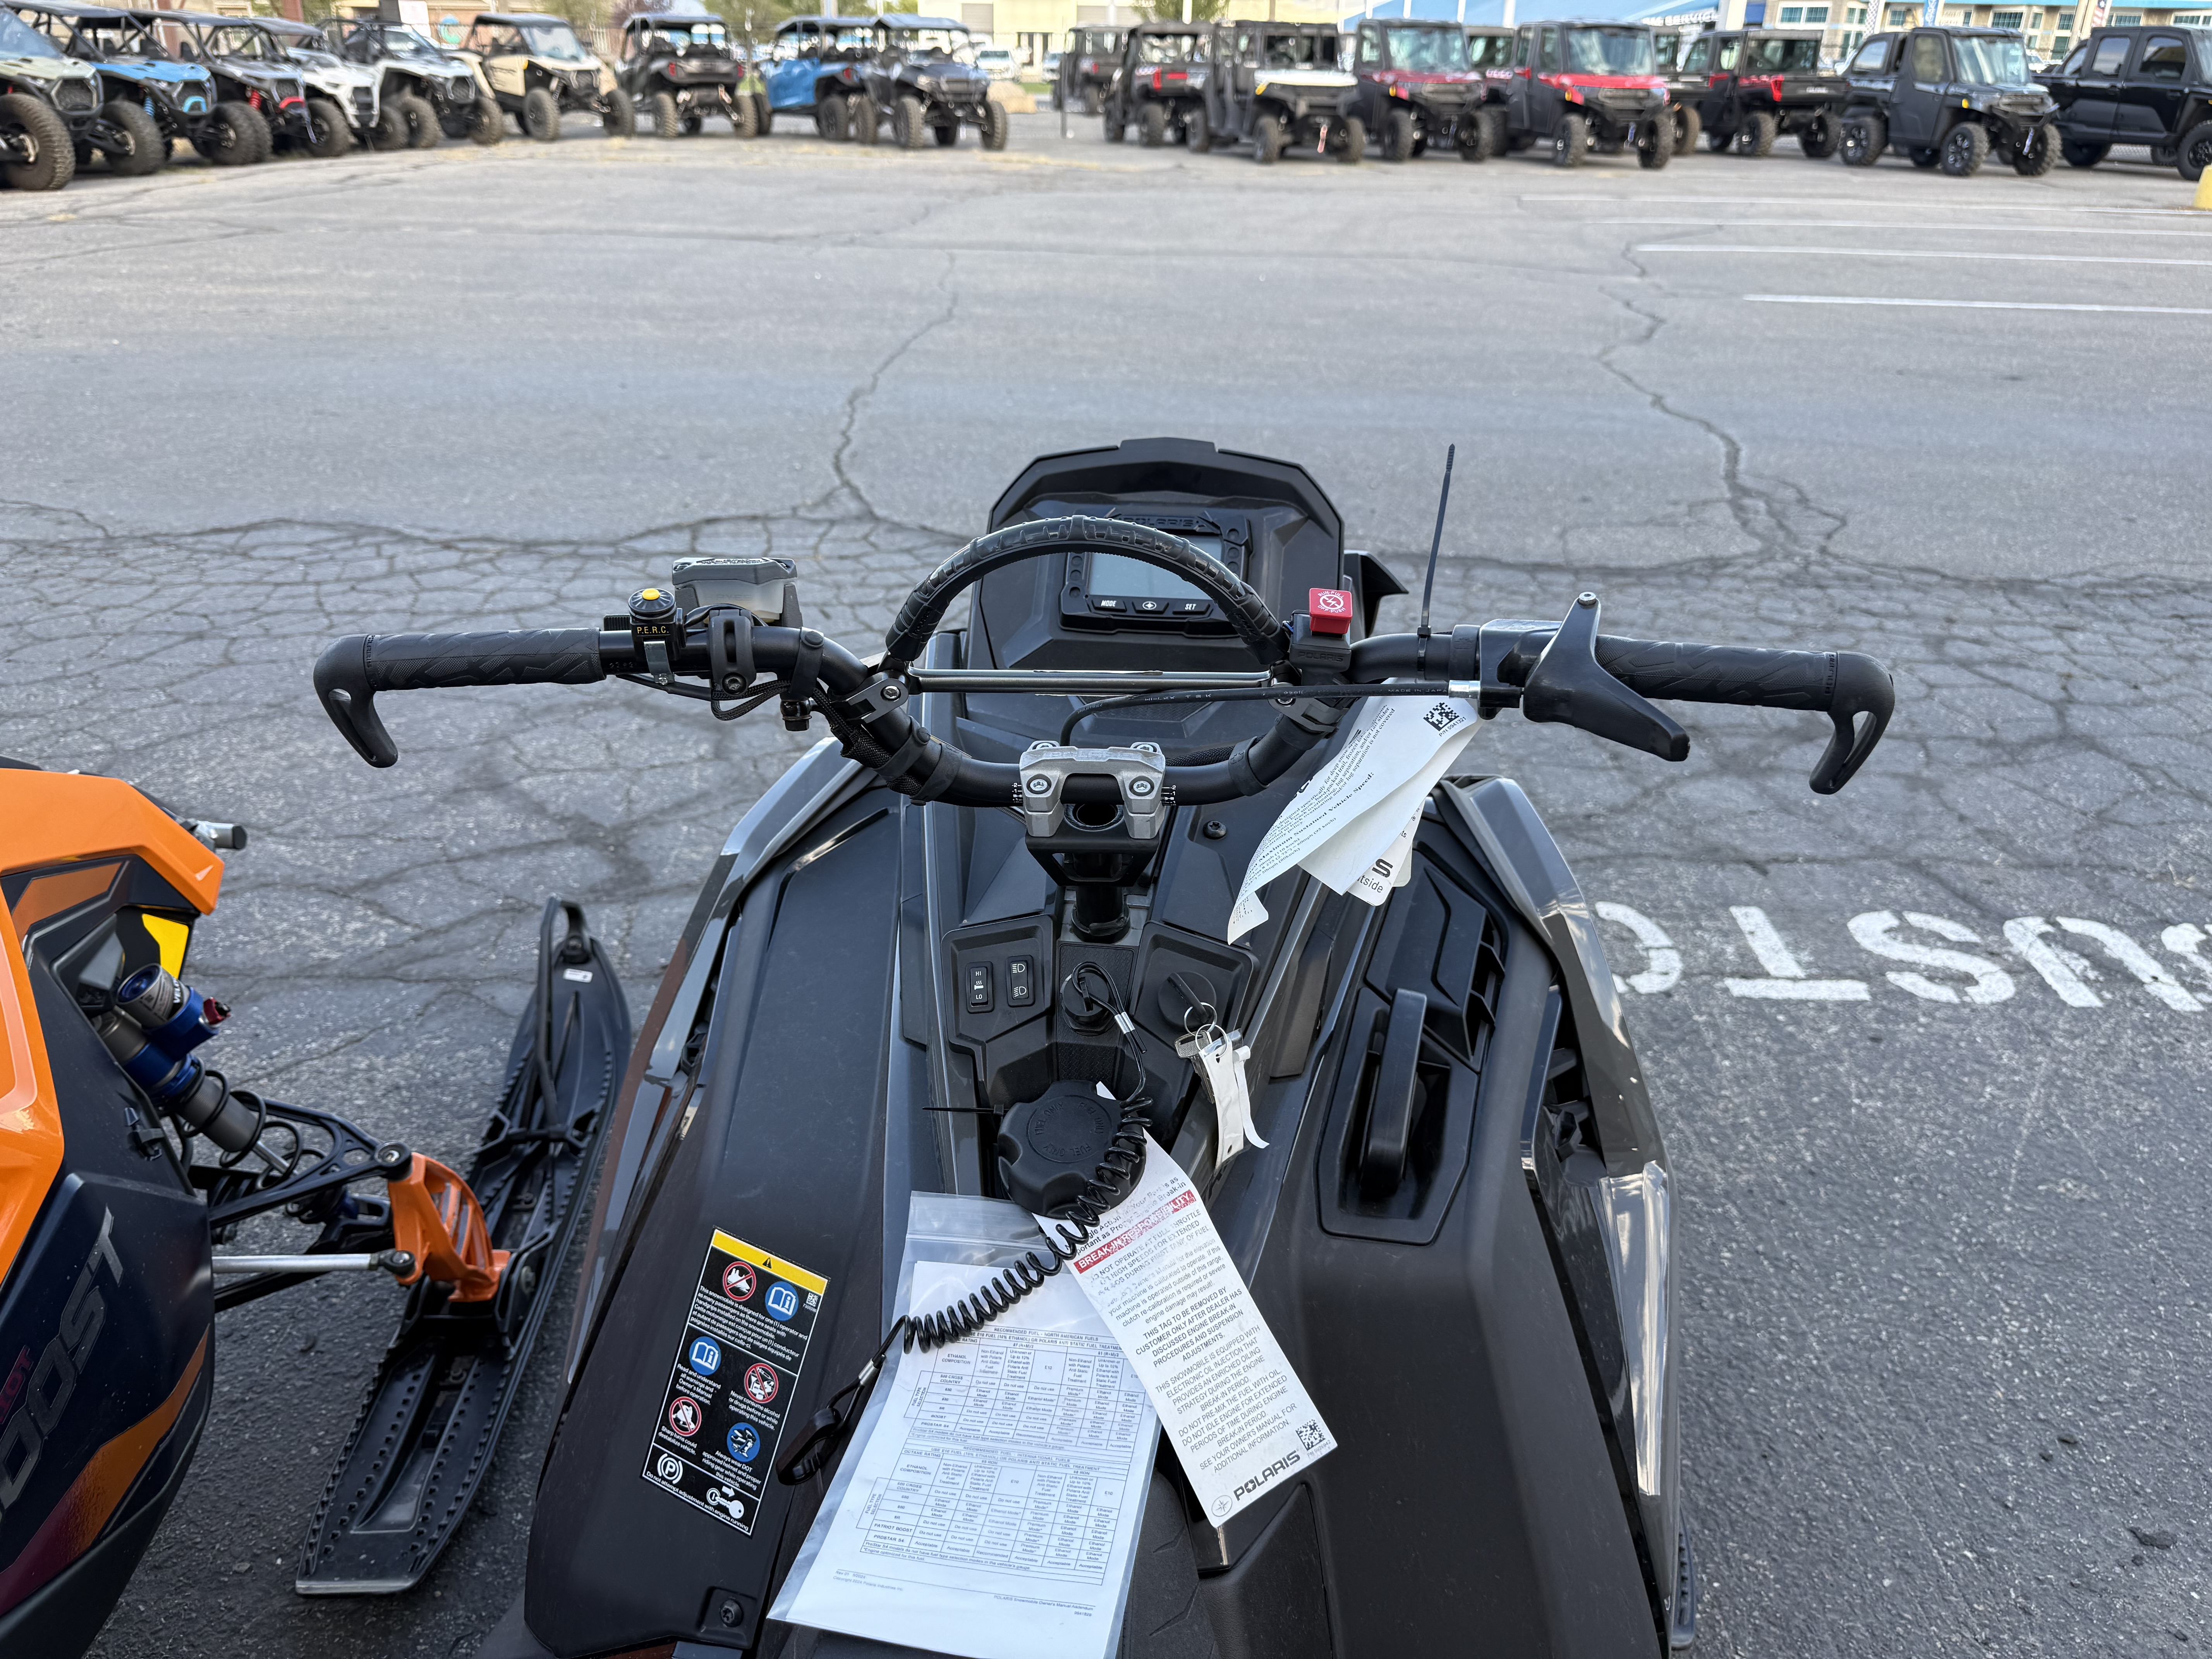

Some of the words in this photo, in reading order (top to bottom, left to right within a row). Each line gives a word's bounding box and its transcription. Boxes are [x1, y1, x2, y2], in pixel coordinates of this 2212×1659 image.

[637, 626, 669, 634] P.E.R.C.
[1298, 651, 1343, 662] POLARIS
[1330, 763, 1339, 775] deep
[1338, 747, 1348, 762] snow
[1335, 777, 1344, 786] lug
[1342, 750, 1361, 777] separation,
[1360, 732, 1371, 749] and/or
[1377, 707, 1389, 721] slider
[1338, 761, 1348, 773] trail,
[1346, 743, 1358, 759] frozen
[1345, 771, 1354, 781] lug
[1353, 745, 1370, 771] separation
[1379, 708, 1395, 729] covered
[1294, 812, 1327, 835] Sustained
[1328, 793, 1352, 811] Vehicle
[1353, 772, 1374, 792] Speed:
[1357, 874, 1384, 893] tside
[1044, 1102, 1063, 1116] ONLY
[1070, 1143, 1092, 1156] FUEL
[1077, 1236, 1123, 1270] BREAK-IN
[1136, 1331, 1171, 1355] CUSTOMER
[1171, 1320, 1187, 1334] ONLY
[1188, 1309, 1207, 1325] AFTER
[1206, 1296, 1230, 1313] DEALER
[1229, 1288, 1242, 1300] HAS
[1143, 1327, 1159, 1339] THIS
[1158, 1319, 1172, 1330] TAG
[1171, 1314, 1181, 1322] TO
[1181, 1308, 1190, 1317] BE
[1190, 1292, 1218, 1312] REMOVED
[1218, 1286, 1226, 1295] BY
[1152, 1332, 1187, 1357] DISCUSSED
[1187, 1319, 1209, 1336] ENGINE
[1208, 1302, 1236, 1323] BREAK-IN
[1153, 1339, 1194, 1367] PROCEDURES
[1195, 1331, 1207, 1343] AND
[1207, 1309, 1243, 1334] SUSPENSION
[0, 1204, 125, 1526] OOST
[1155, 1380, 1170, 1393] THIS
[1170, 1356, 1209, 1384] SNOWMOBILE
[1209, 1352, 1216, 1360] IS
[1215, 1334, 1245, 1356] EQUIPPED
[1244, 1324, 1260, 1338] WITH
[1166, 1371, 1204, 1398] ELECTRONIC
[1204, 1365, 1214, 1374] OIL
[1213, 1346, 1243, 1368] INJECTION
[1242, 1336, 1257, 1350] THAT
[1183, 1332, 1225, 1361] ADJUSTMENTS.
[1172, 1382, 1203, 1406] PROVIDES
[1203, 1377, 1212, 1387] AN
[1211, 1358, 1241, 1381] ENRICHED
[1241, 1346, 1261, 1362] OILING
[1177, 1390, 1207, 1414] STRATEGY
[1207, 1376, 1231, 1395] DURING
[1230, 1368, 1243, 1380] THE
[1242, 1355, 1265, 1372] ENGINE
[1200, 1389, 1228, 1411] BREAK-IN
[729, 1405, 750, 1419] operating
[750, 1414, 758, 1422] this
[758, 1419, 775, 1430] vehicle.
[730, 1390, 744, 1400] Never
[743, 1398, 764, 1410] consume
[763, 1407, 780, 1419] alcohol
[733, 1400, 747, 1409] drugs
[746, 1405, 761, 1416] before
[766, 1416, 778, 1425] while
[1178, 1426, 1188, 1437] DO
[1188, 1417, 1201, 1431] NOT
[1202, 1402, 1227, 1422] PRE-MIX
[1225, 1394, 1238, 1406] THE
[1238, 1386, 1254, 1398] FUEL
[1252, 1375, 1269, 1389] WITH
[1268, 1369, 1282, 1378] OIL.
[1182, 1436, 1192, 1446] DO
[1192, 1426, 1205, 1440] NOT
[1205, 1418, 1220, 1431] IDLE
[1219, 1403, 1242, 1422] ENGINE
[1241, 1395, 1254, 1408] FOR
[1253, 1375, 1287, 1400] EXTENDED
[1190, 1431, 1217, 1453] PERIODS
[1217, 1424, 1225, 1434] OF
[1225, 1415, 1241, 1429] TIME
[1240, 1401, 1263, 1420] DURING
[1262, 1385, 1288, 1405] ENGINE
[1217, 1424, 1245, 1447] BREAK-IN
[1244, 1410, 1266, 1429] PERIOD.
[1199, 1457, 1213, 1470] SEE
[1212, 1446, 1230, 1461] YOUR
[1230, 1428, 1256, 1449] OWNER'S
[1255, 1413, 1283, 1432] MANUAL
[1281, 1403, 1297, 1416] FOR
[1214, 1446, 1248, 1473] ADDITIONAL
[1247, 1419, 1291, 1449] INFORMATION.
[1233, 1450, 1300, 1501] POLARIS
[661, 1480, 679, 1492] attempt
[678, 1490, 704, 1507] adjustment
[704, 1504, 714, 1512] with
[714, 1510, 730, 1521] engine
[730, 1518, 749, 1531] running
